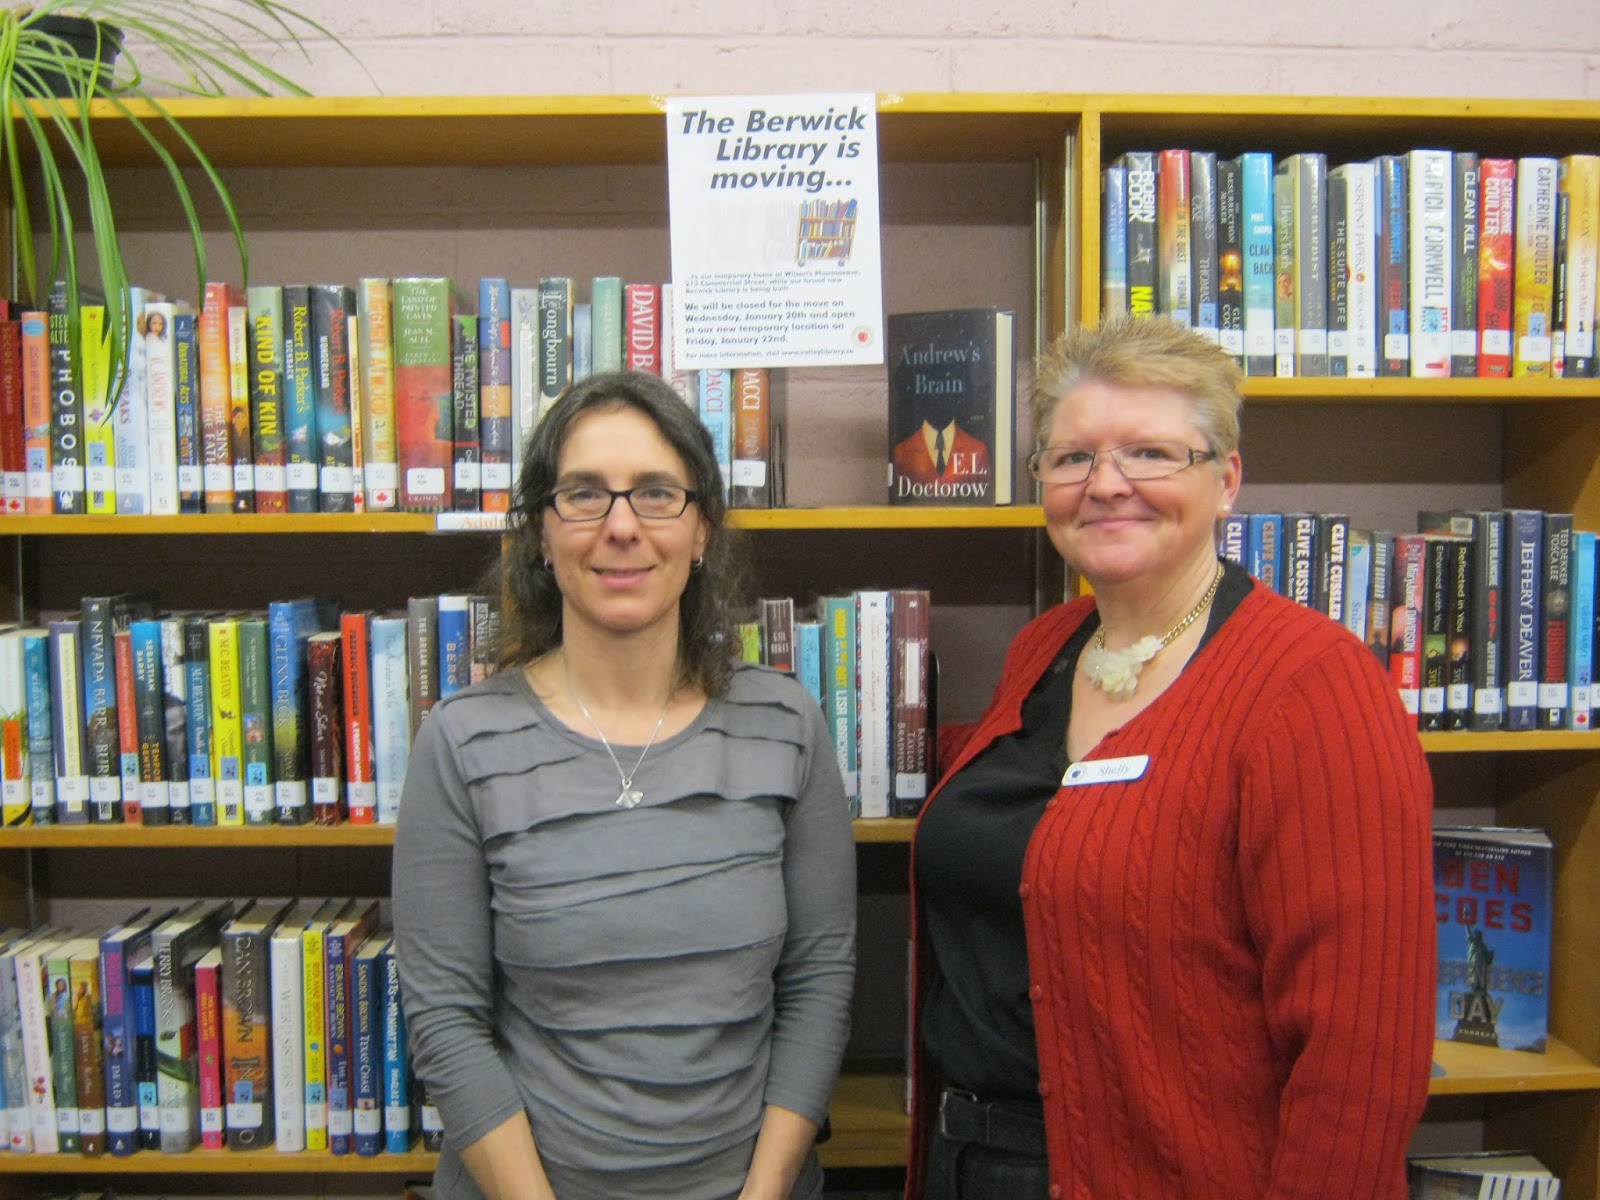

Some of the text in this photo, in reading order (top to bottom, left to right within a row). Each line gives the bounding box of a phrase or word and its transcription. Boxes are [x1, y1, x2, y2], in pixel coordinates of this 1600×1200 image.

[682, 106, 868, 134] The Berwick
[717, 136, 860, 165] Library is
[710, 165, 852, 193] moving...
[1128, 171, 1142, 223] COOK
[1143, 171, 1155, 223] ROBIN
[1354, 182, 1365, 229] SERPENT
[1463, 171, 1475, 255] CLEAN KILL
[1484, 177, 1500, 235] COULTER
[1500, 178, 1512, 235] CATHERINE
[1534, 167, 1551, 285] CATHERINE COULTER
[1249, 244, 1270, 256] CLAW
[1337, 219, 1346, 324] THE SUITE LIFE
[1424, 225, 1444, 299] CORNWELL
[685, 302, 699, 310] We
[702, 301, 719, 310] will
[736, 300, 766, 309] closed
[768, 300, 782, 308] for
[785, 300, 800, 308] the
[1199, 258, 1211, 303] THOMAS
[540, 291, 563, 387] Longbourn
[632, 290, 654, 350] DAVID
[685, 310, 855, 322] Wednesday, January 20th and open
[686, 336, 759, 347] Friday, January
[739, 324, 789, 333] temporary
[791, 323, 829, 331] location
[177, 342, 190, 384] UNNATURAL
[256, 316, 277, 435] KIND OF KIN
[285, 339, 294, 381] KICKBACK
[293, 305, 310, 414] Robert B. Parker's
[319, 336, 330, 389] WONDERLAND
[330, 309, 347, 416] Robert B. Parker's
[900, 341, 981, 366] Andrew's
[454, 354, 465, 409] THREAD
[465, 337, 477, 428] THE TWISTED
[706, 369, 723, 412] DACCI
[915, 372, 963, 395] Brain
[58, 350, 77, 467] PHOBOS
[214, 404, 229, 458] THE SINS
[204, 407, 216, 466] THE FATH
[898, 475, 989, 498] Doctorow
[952, 452, 988, 475] E.L.
[1262, 521, 1275, 561] CLIVE
[1295, 519, 1311, 607] CLIVE CUSSL
[1550, 533, 1560, 581] TOSCA LEE
[1559, 528, 1569, 585] TED DEKKER
[1329, 523, 1344, 621] CLIVE CUSSLER
[1433, 545, 1443, 632] Entwined with You
[1456, 546, 1467, 633] Reflected in You
[1403, 563, 1419, 653] MaryJanice DAVIDSON
[1519, 540, 1536, 681] JEFFERY DEAVER
[90, 620, 107, 728] NEVADA BARR
[136, 650, 145, 681] BARRY
[145, 639, 155, 692] SEBASTIAN
[220, 659, 231, 699] BEATON
[275, 635, 291, 729] GLENN BECK
[419, 617, 429, 696] THE DREAM LOVER
[446, 642, 457, 685] BERG
[192, 683, 204, 723] BEATON
[836, 689, 848, 715] LISA
[896, 722, 905, 772] BRADFOR
[907, 732, 916, 771] TAYLOR
[1097, 764, 1130, 776] Shelly
[1443, 858, 1520, 895] BEN
[1436, 893, 1533, 934] COES
[159, 941, 172, 976] TERRY
[235, 936, 252, 974] DAN
[237, 979, 253, 1043] BROWN
[313, 962, 322, 1036] RITA MAE BROWN
[335, 964, 344, 1039] RITA MAE BROWN
[387, 959, 398, 1060] GHOSTS MANHATTAN
[1449, 991, 1504, 1025] DAY
[358, 964, 370, 1094] SANDRA BROWN CHASE
[111, 1065, 123, 1098] DEAD
